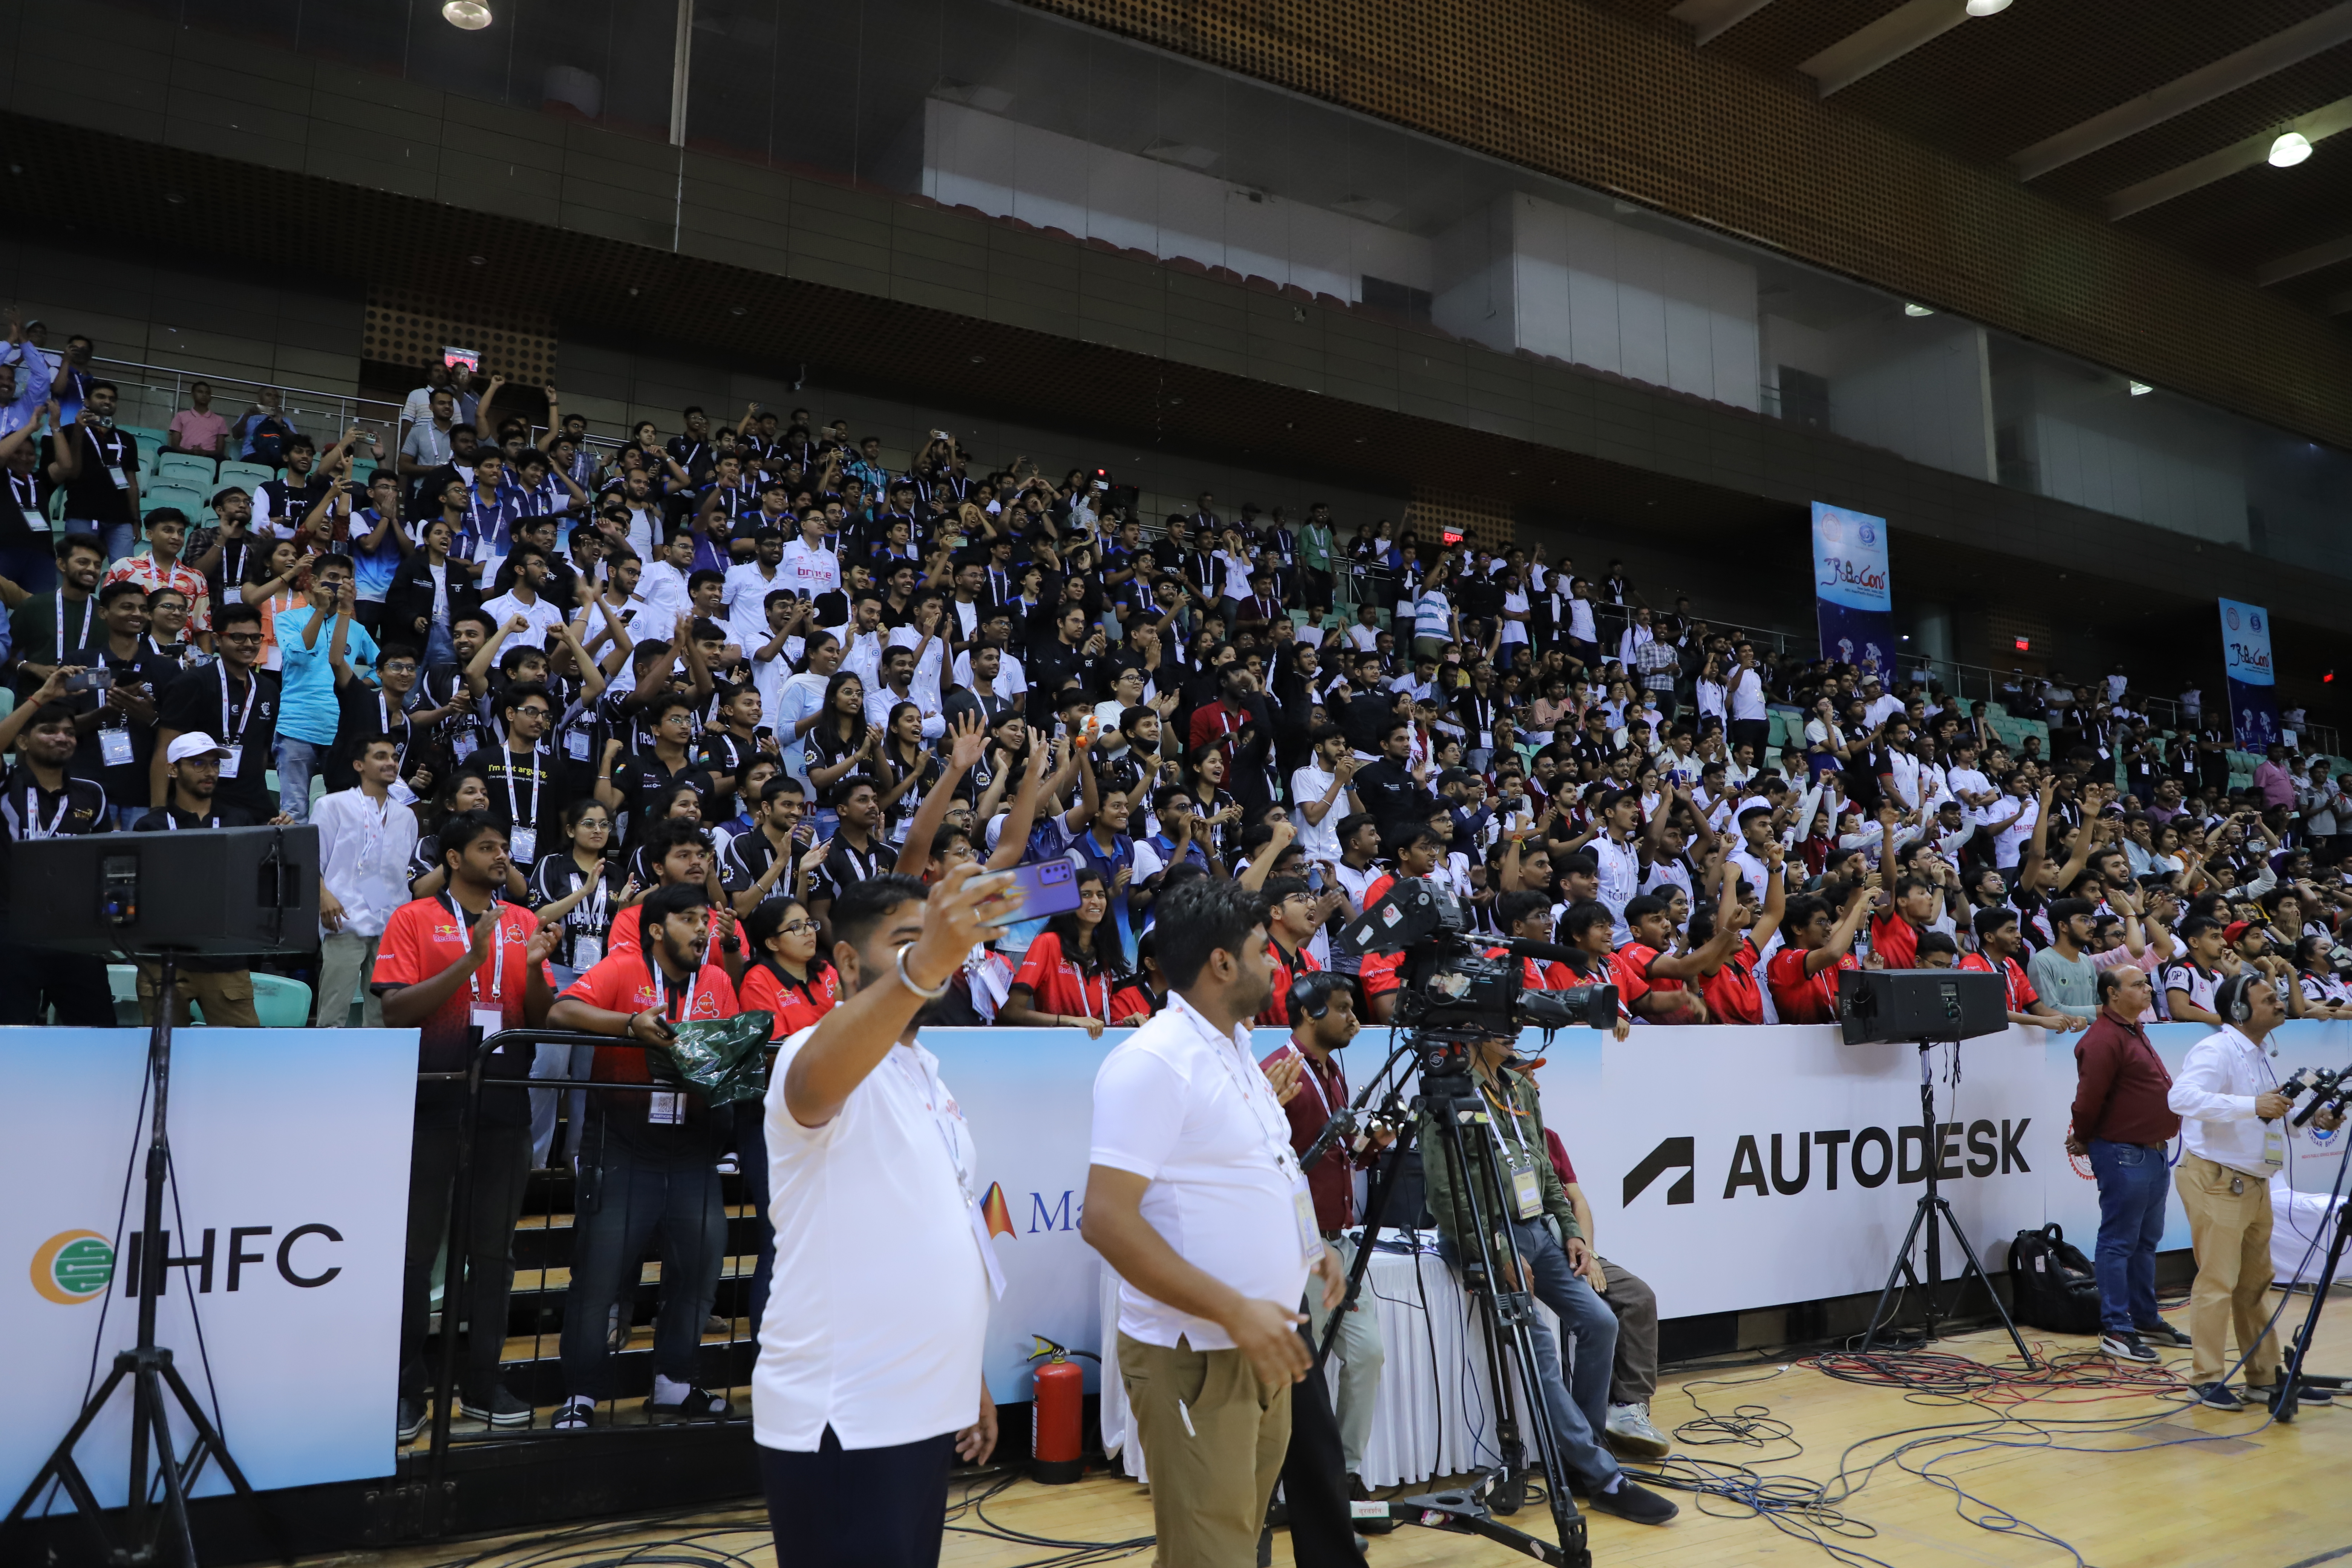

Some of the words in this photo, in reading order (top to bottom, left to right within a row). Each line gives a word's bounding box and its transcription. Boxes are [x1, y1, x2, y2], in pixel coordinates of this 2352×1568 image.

[1445, 533, 1462, 542] EXIT
[518, 767, 548, 778] argung.
[449, 933, 463, 942] Bul
[1058, 966, 1071, 974] Red
[634, 994, 645, 1004] Red
[2325, 1129, 2340, 1147] BHARA
[1723, 1118, 2031, 1199] AUTODESK
[2076, 1161, 2087, 1173] INSTITUTE
[126, 1223, 344, 1297] IHFC
